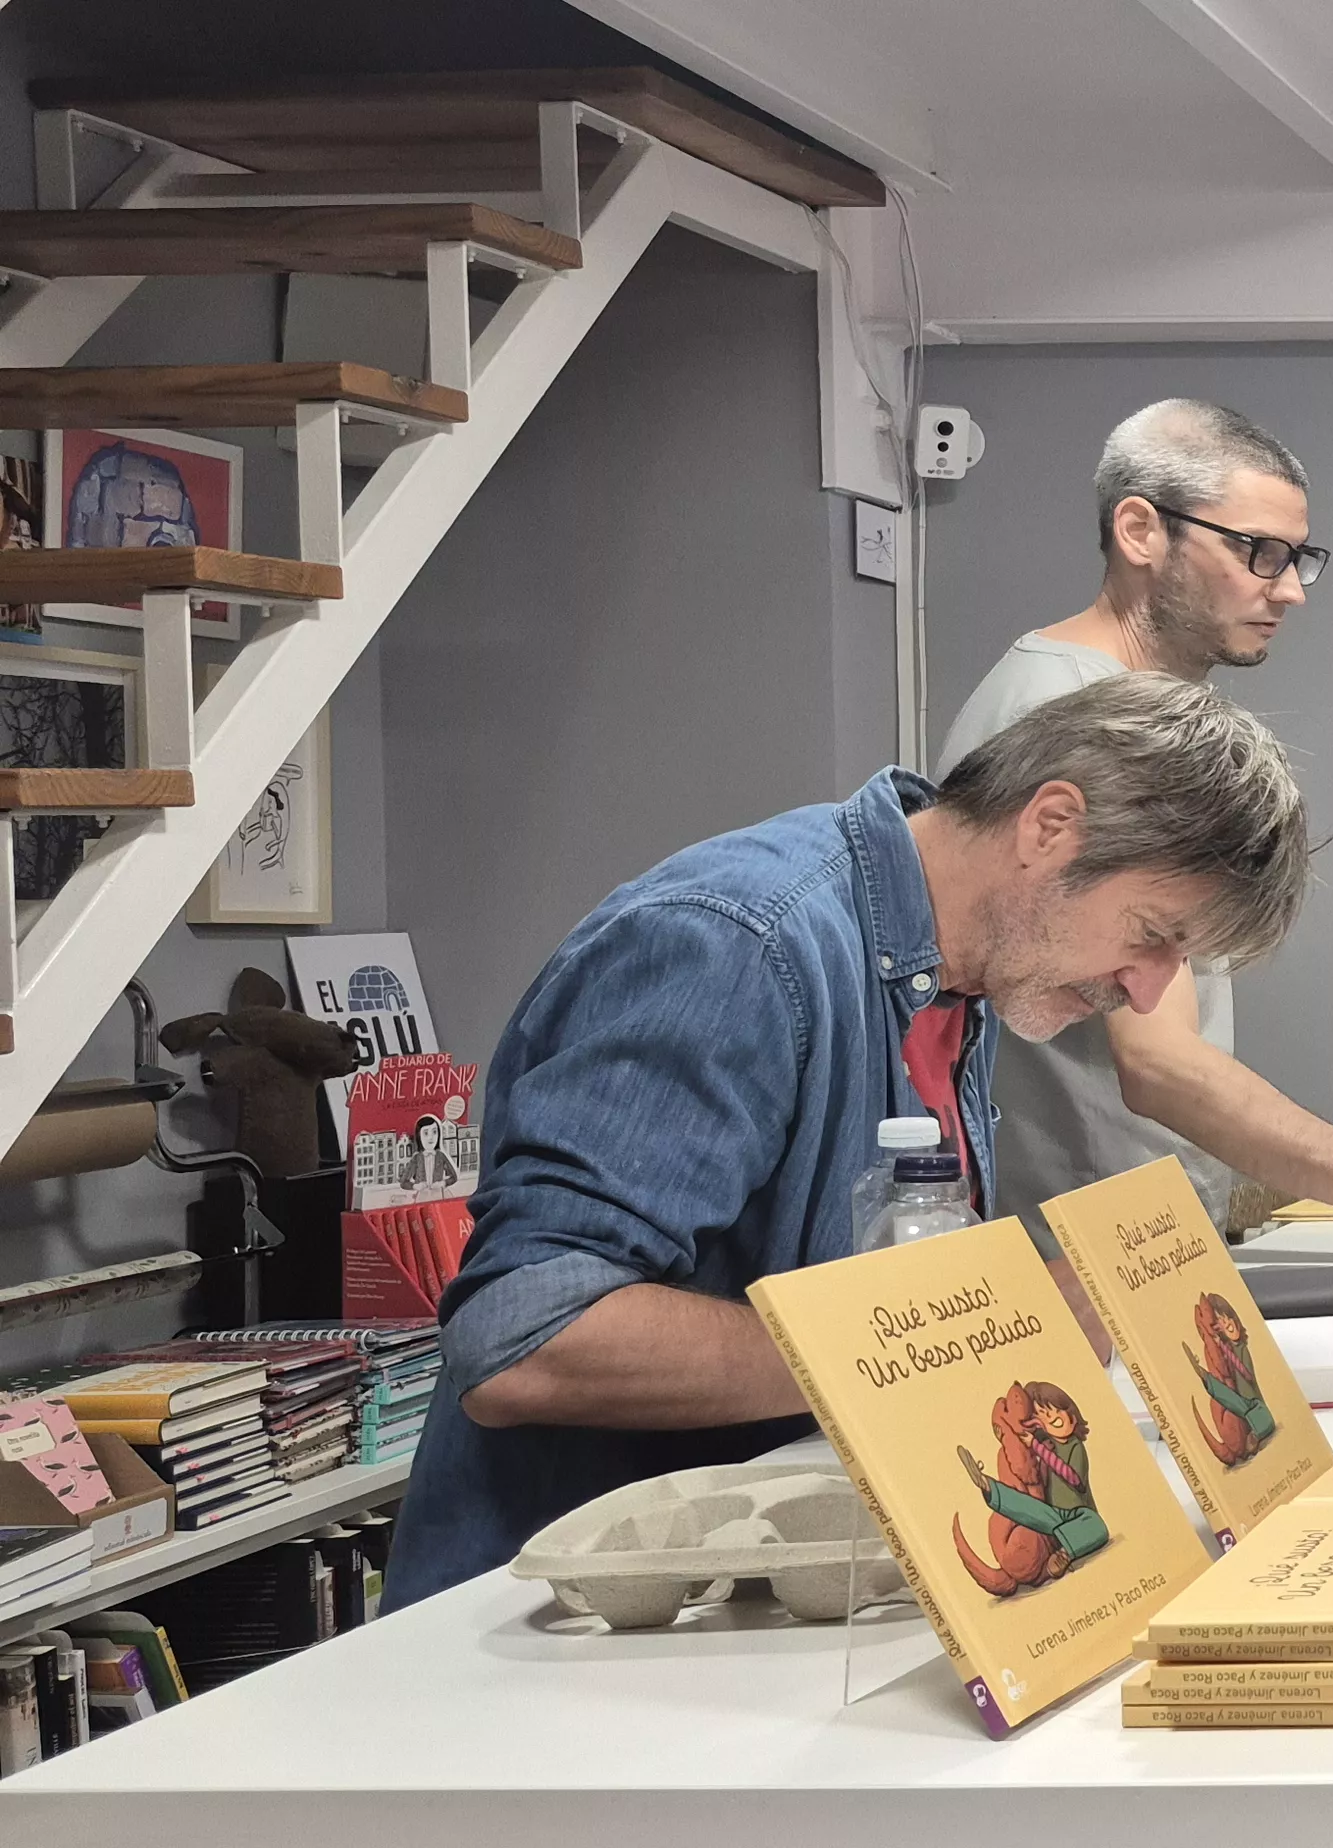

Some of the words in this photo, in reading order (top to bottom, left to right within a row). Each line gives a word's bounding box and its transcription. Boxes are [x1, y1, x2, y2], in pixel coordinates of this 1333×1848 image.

[317, 979, 344, 1013] EL
[327, 1009, 423, 1067] GLÚ
[383, 1056, 397, 1069] EL
[398, 1055, 435, 1068] DIARIO
[437, 1053, 451, 1065] DE
[351, 1068, 409, 1103] ANNE
[413, 1063, 476, 1099] FRANK
[1056, 1224, 1074, 1249] Roca
[1115, 1214, 1147, 1259] ¡Qué
[1146, 1203, 1181, 1240] susto!
[1070, 1247, 1087, 1273] Paco
[1083, 1269, 1091, 1279] y
[1117, 1263, 1146, 1292] Un
[1141, 1253, 1172, 1281] beso
[1171, 1232, 1208, 1277] peludo
[1086, 1275, 1112, 1319] Jiménez
[765, 1310, 786, 1342] Roca
[869, 1299, 926, 1350] ¡Qué
[927, 1276, 998, 1321] susto!
[856, 1357, 910, 1388] Un
[906, 1341, 964, 1373] beso
[966, 1310, 1042, 1365] peludo
[1106, 1317, 1128, 1352] Lorena
[783, 1338, 801, 1370] Paco
[798, 1368, 807, 1377] y
[1131, 1362, 1158, 1402] peludo
[804, 1374, 838, 1434] Jiménez
[1153, 1400, 1171, 1430] beso
[830, 1430, 856, 1465] Lorena
[1166, 1428, 1180, 1453] Un
[1175, 1449, 1201, 1488] susto!
[858, 1477, 890, 1524] peludo
[1195, 1486, 1217, 1515] ¡Qué
[887, 1521, 912, 1558] beso
[903, 1555, 921, 1588] Un
[1249, 1562, 1299, 1587] ¡Qué
[1284, 1529, 1332, 1560] susto!
[1277, 1579, 1327, 1601] Un
[916, 1583, 948, 1629] susto!
[1026, 1629, 1068, 1659] Lorena
[1067, 1604, 1111, 1637] Jiménez
[1109, 1602, 1118, 1616] y
[1115, 1586, 1142, 1608] Paco
[1139, 1573, 1167, 1595] Roca
[941, 1626, 969, 1661] ¡Qué
[1179, 1628, 1209, 1638] Roca
[1214, 1627, 1242, 1638] Paco
[1247, 1626, 1252, 1635] y
[1257, 1625, 1309, 1637] Jiménez
[1182, 1672, 1212, 1682] Roca
[1216, 1672, 1245, 1682] Paco
[1250, 1672, 1256, 1680] y
[1260, 1670, 1310, 1682] Jiménez
[1152, 1711, 1181, 1721] Roca
[1185, 1710, 1214, 1721] Paco
[1218, 1710, 1223, 1719] y
[1228, 1708, 1276, 1720] Jiménez
[1282, 1710, 1323, 1720] Lorena
